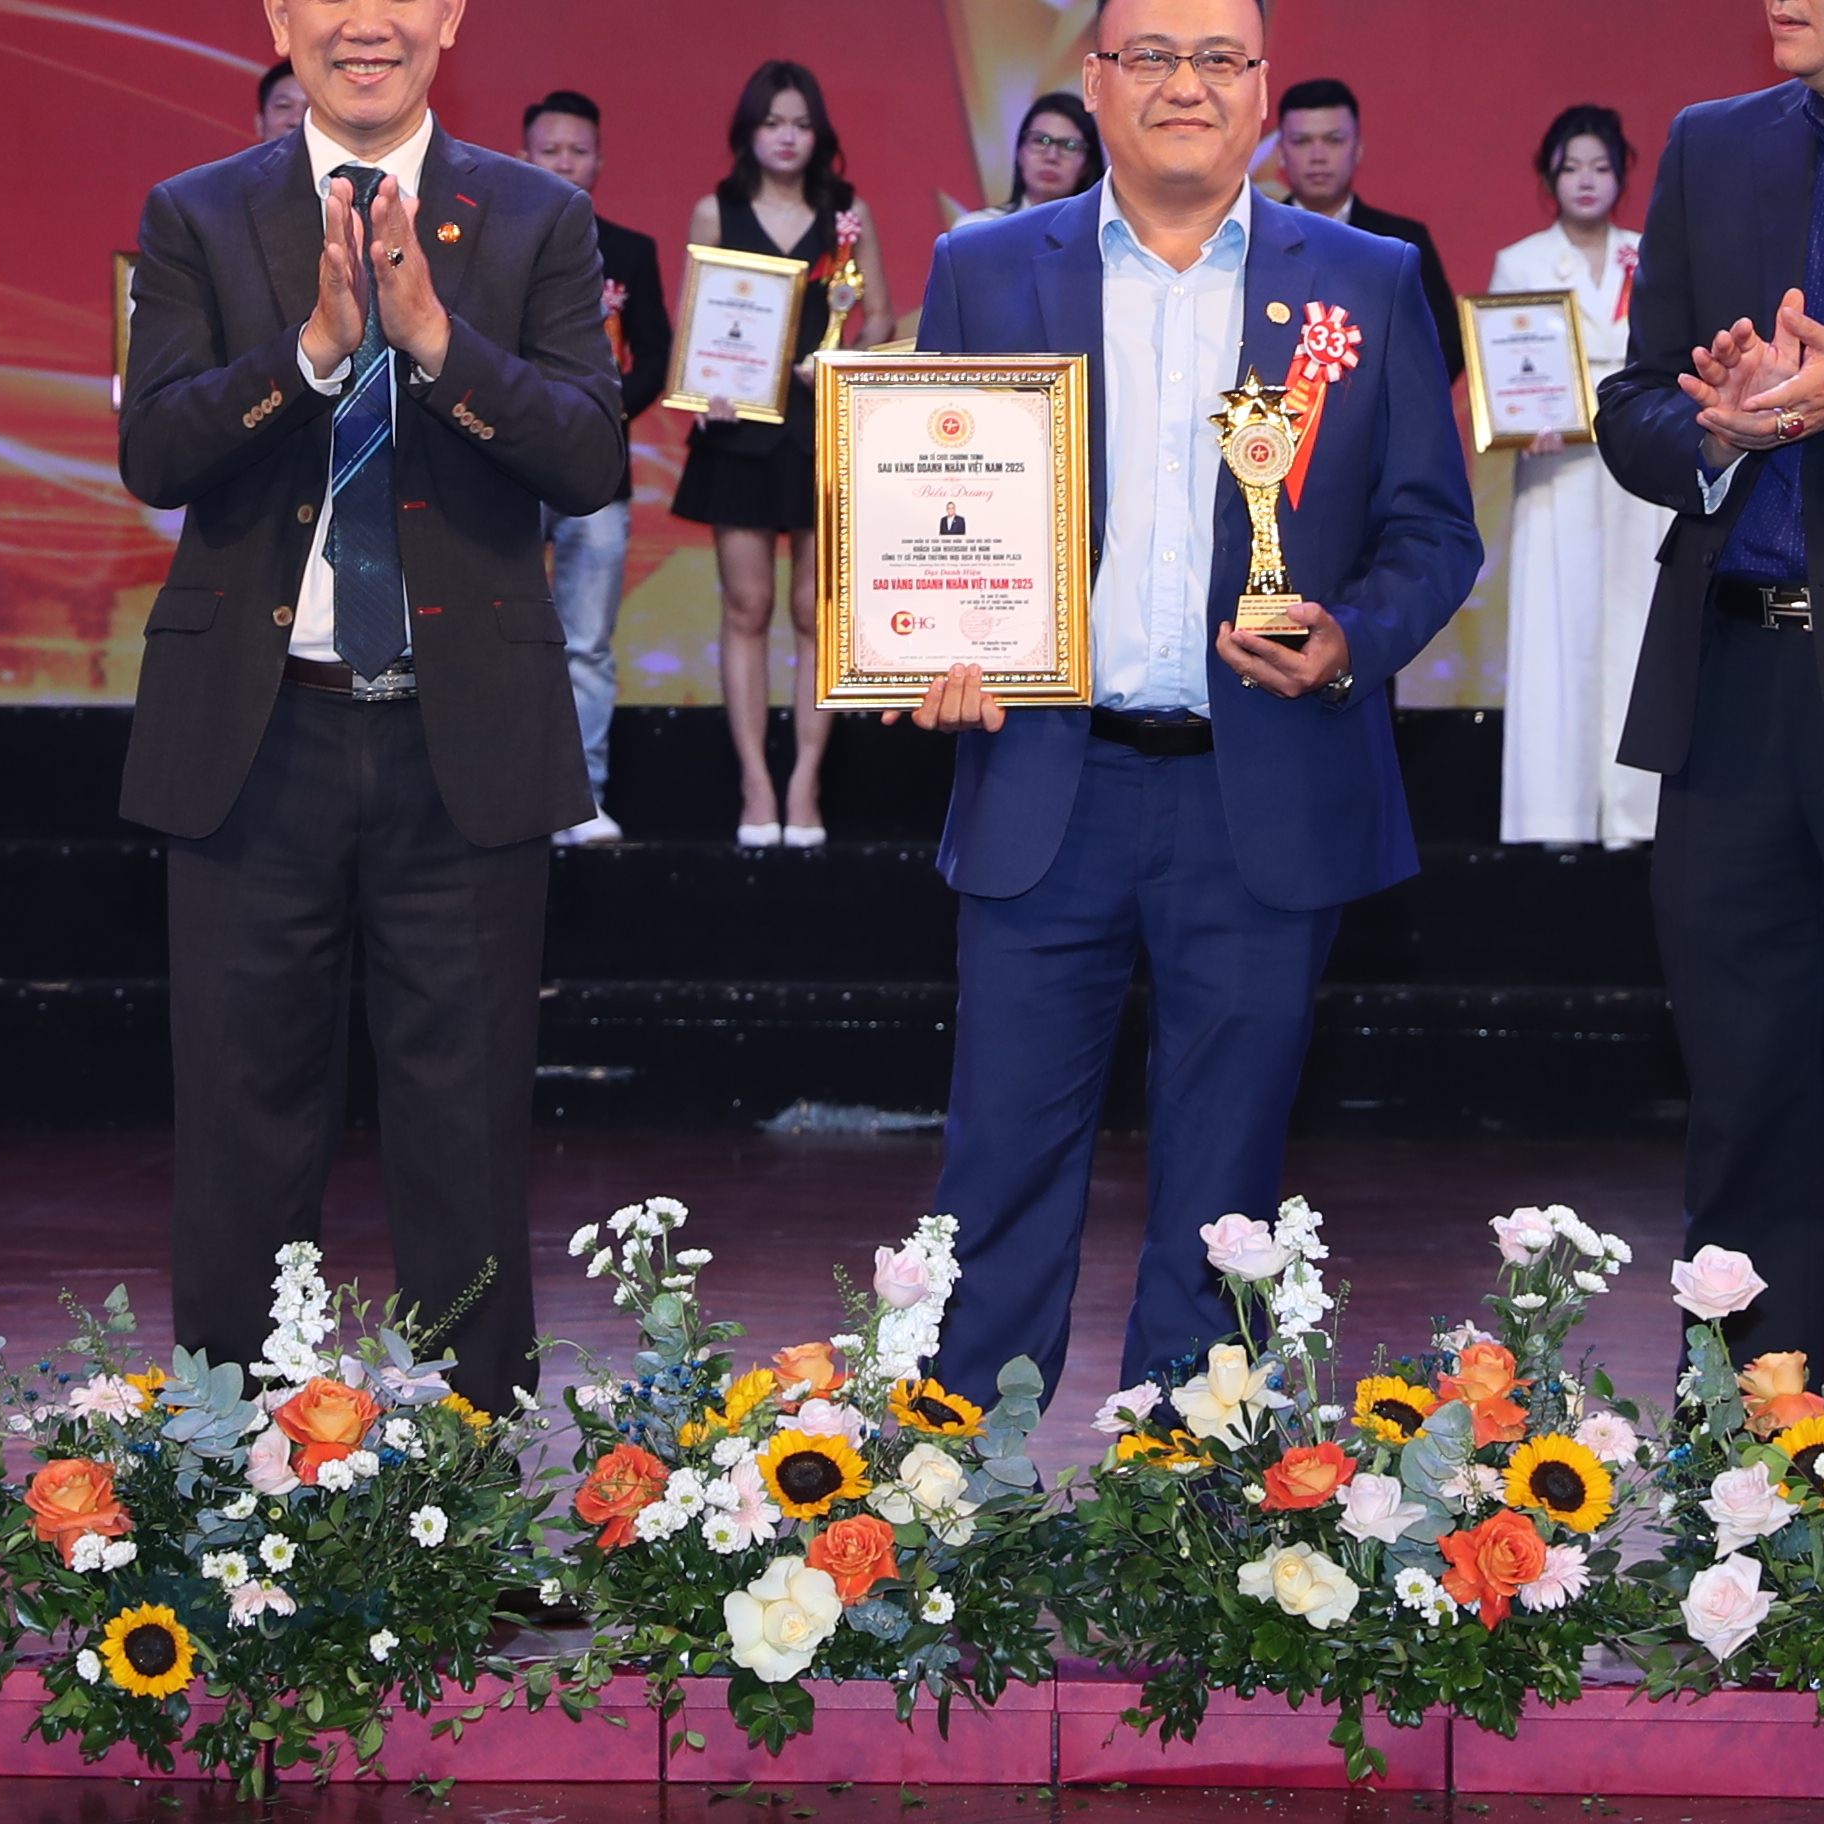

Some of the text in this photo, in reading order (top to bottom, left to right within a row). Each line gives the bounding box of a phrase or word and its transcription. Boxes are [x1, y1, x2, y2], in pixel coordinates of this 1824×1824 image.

[1308, 325, 1347, 358] 33
[873, 576, 1033, 592] SAO VÀNG DOANH NHÂN VIỆT NAM 2025
